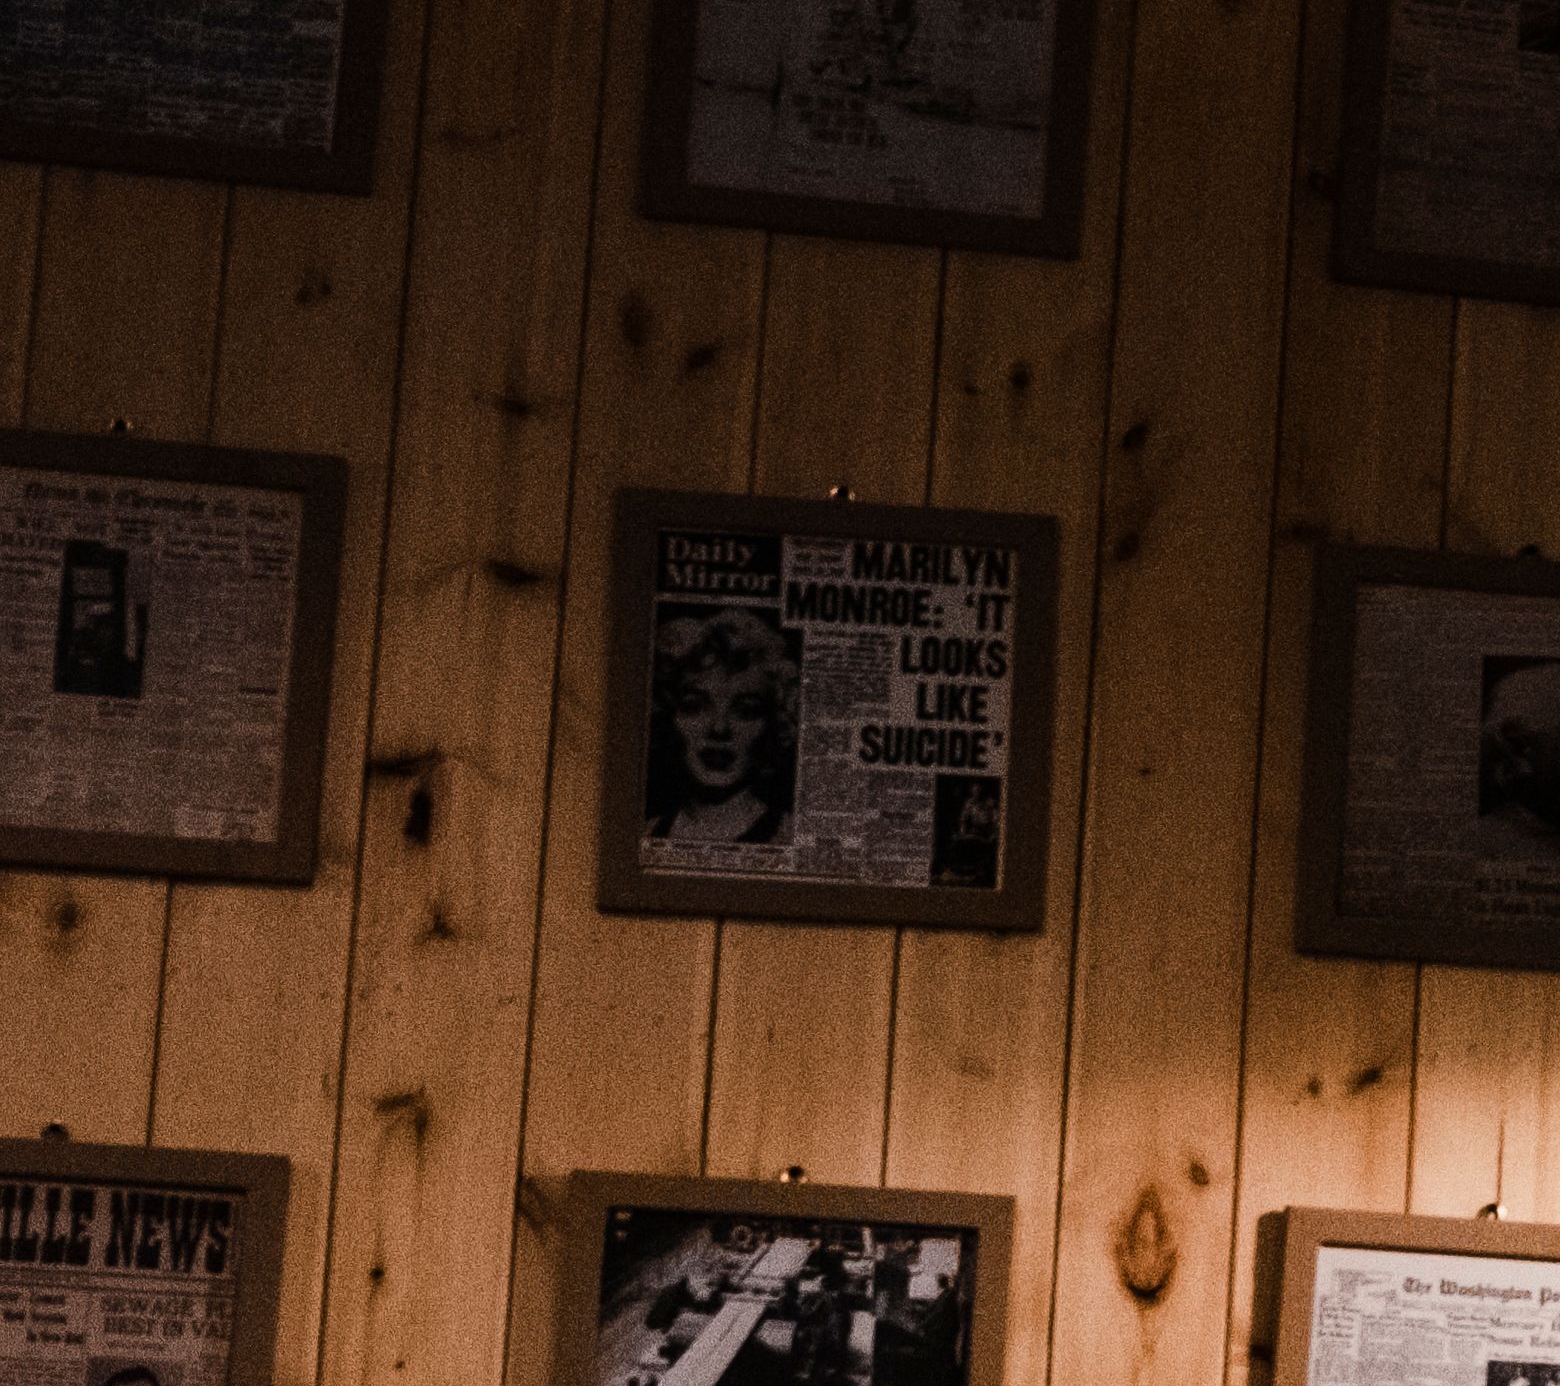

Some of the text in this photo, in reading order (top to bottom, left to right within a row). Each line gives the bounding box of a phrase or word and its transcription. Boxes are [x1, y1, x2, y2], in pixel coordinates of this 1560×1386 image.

[665, 535, 759, 567] Daily
[852, 543, 1011, 589] MARILYN
[664, 563, 778, 592] Mirror
[786, 582, 943, 629] MONROE:
[901, 634, 1008, 680] LOOKS
[916, 682, 989, 724] LIKE
[105, 1188, 231, 1274] NEWS
[1402, 1276, 1432, 1296] The
[1439, 1278, 1533, 1305] Washington
